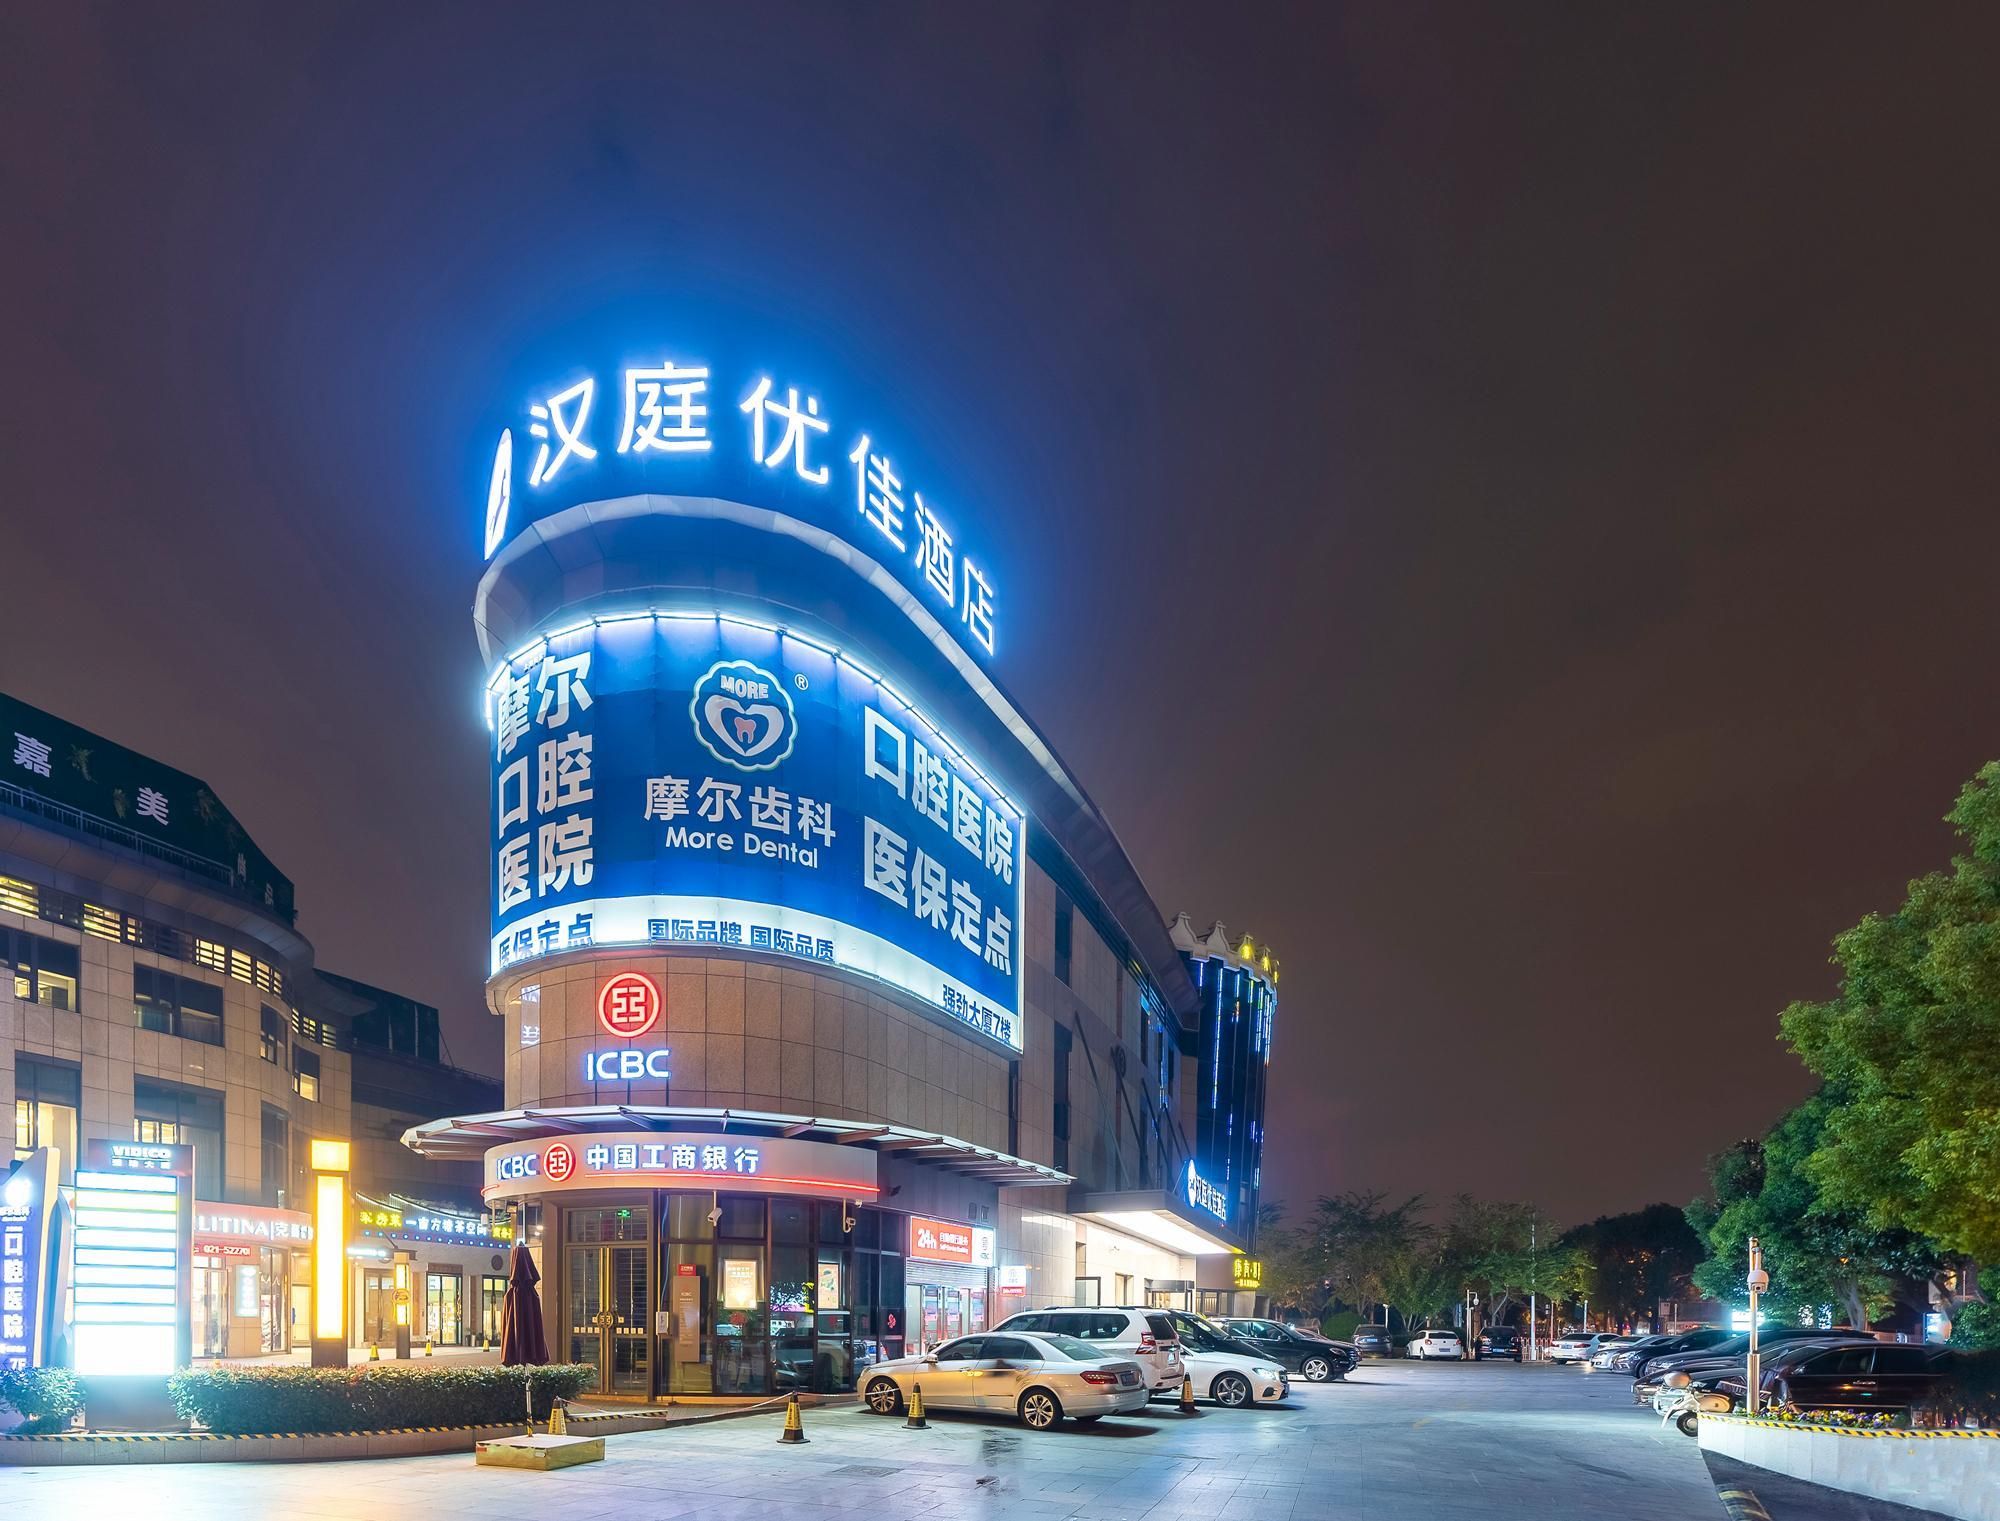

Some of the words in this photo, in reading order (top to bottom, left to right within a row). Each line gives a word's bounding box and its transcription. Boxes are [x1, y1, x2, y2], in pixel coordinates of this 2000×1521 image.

[529, 361, 996, 657] 汉庭优佳酒店
[719, 674, 769, 701] MORE
[498, 731, 594, 840] 口腔
[864, 705, 1013, 886] 口腔医院
[643, 774, 836, 848] 摩尔齿科
[498, 812, 594, 917] 医院
[665, 826, 734, 850] More
[744, 832, 818, 868] Dental
[864, 815, 1012, 976] 医保定点
[498, 913, 594, 968] 医保定点
[647, 918, 742, 944] 国际品牌
[750, 925, 834, 962] 国际品质
[942, 984, 1012, 1044] 强劲大厦7楼
[586, 1049, 671, 1081] ICBC
[112, 1145, 172, 1159] VIDICO
[496, 1154, 540, 1180] ICBC
[586, 1144, 760, 1175] 中国工商银行
[193, 1215, 269, 1236] LITINA
